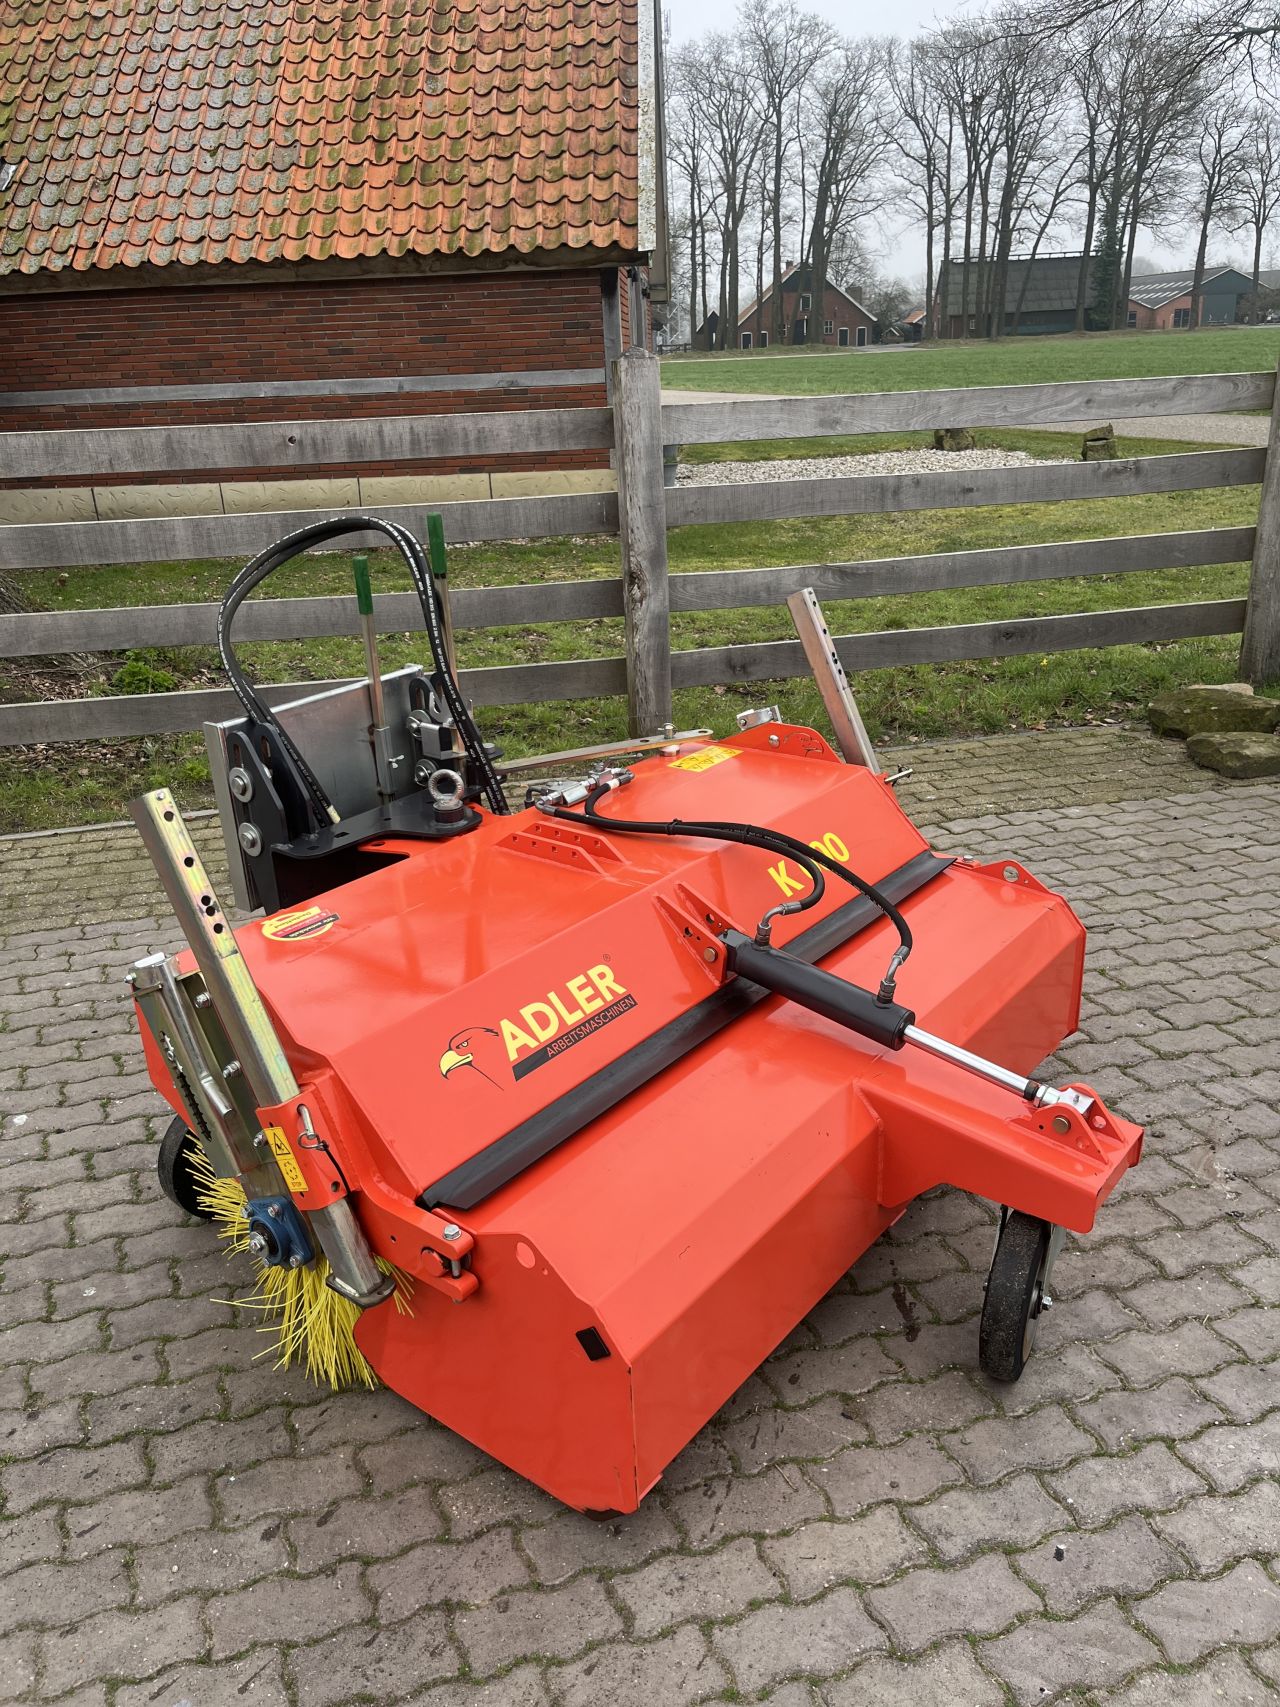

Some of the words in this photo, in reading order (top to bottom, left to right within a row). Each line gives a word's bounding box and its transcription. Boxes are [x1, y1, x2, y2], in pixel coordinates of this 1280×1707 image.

[767, 859, 806, 898] K
[499, 964, 627, 1062] ADLER
[546, 996, 636, 1058] ARBEITSMASCHINEN
